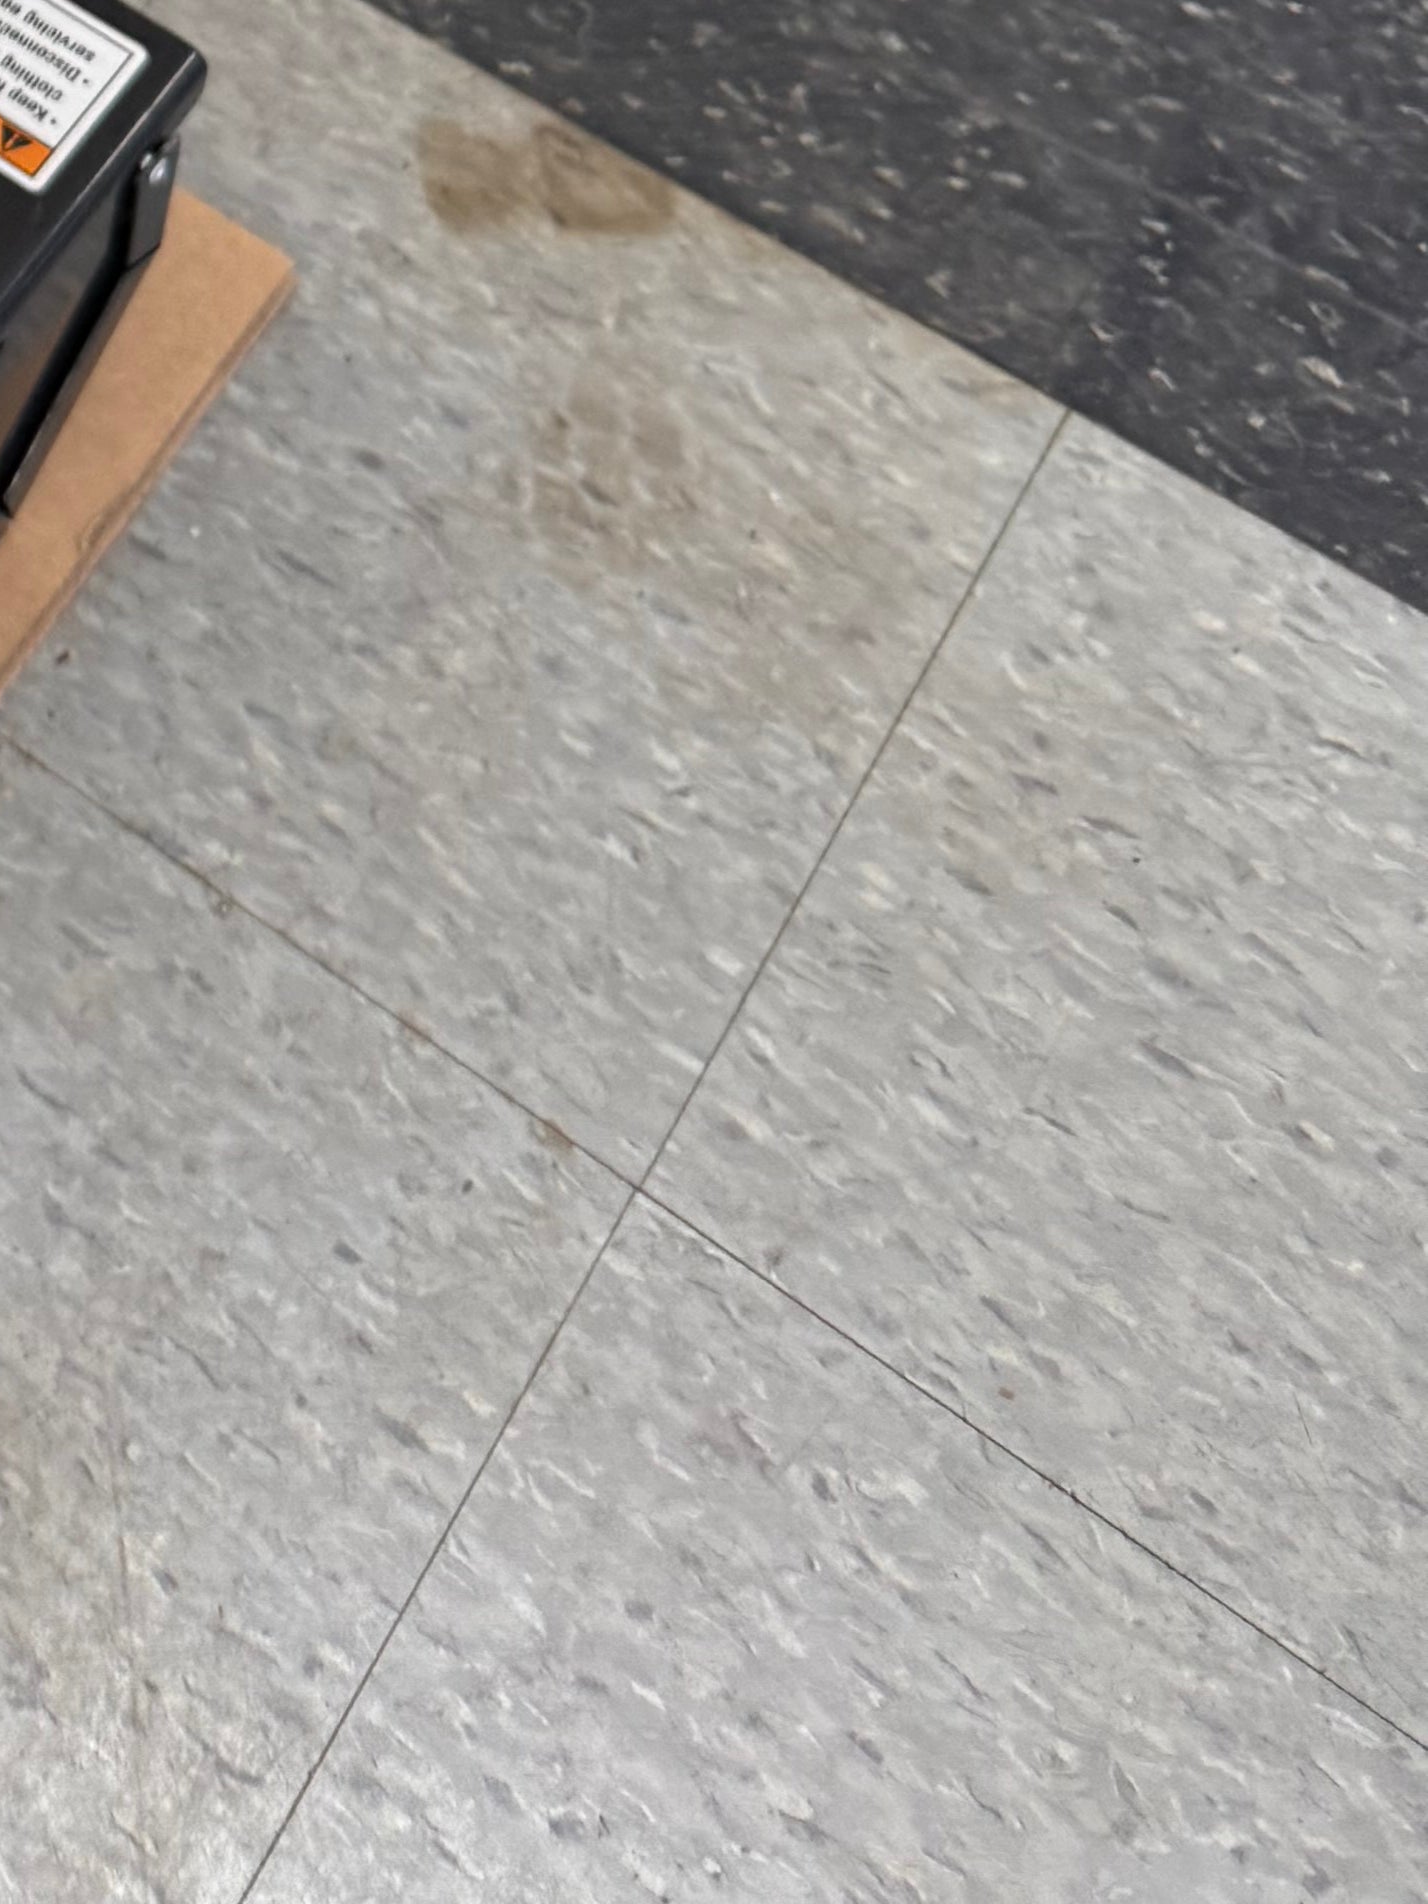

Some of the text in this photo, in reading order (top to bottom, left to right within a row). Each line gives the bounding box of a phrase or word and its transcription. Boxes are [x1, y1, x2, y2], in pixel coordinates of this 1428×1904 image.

[23, 9, 96, 63] servicing
[0, 54, 64, 101] clothing
[8, 88, 48, 122] Keep
